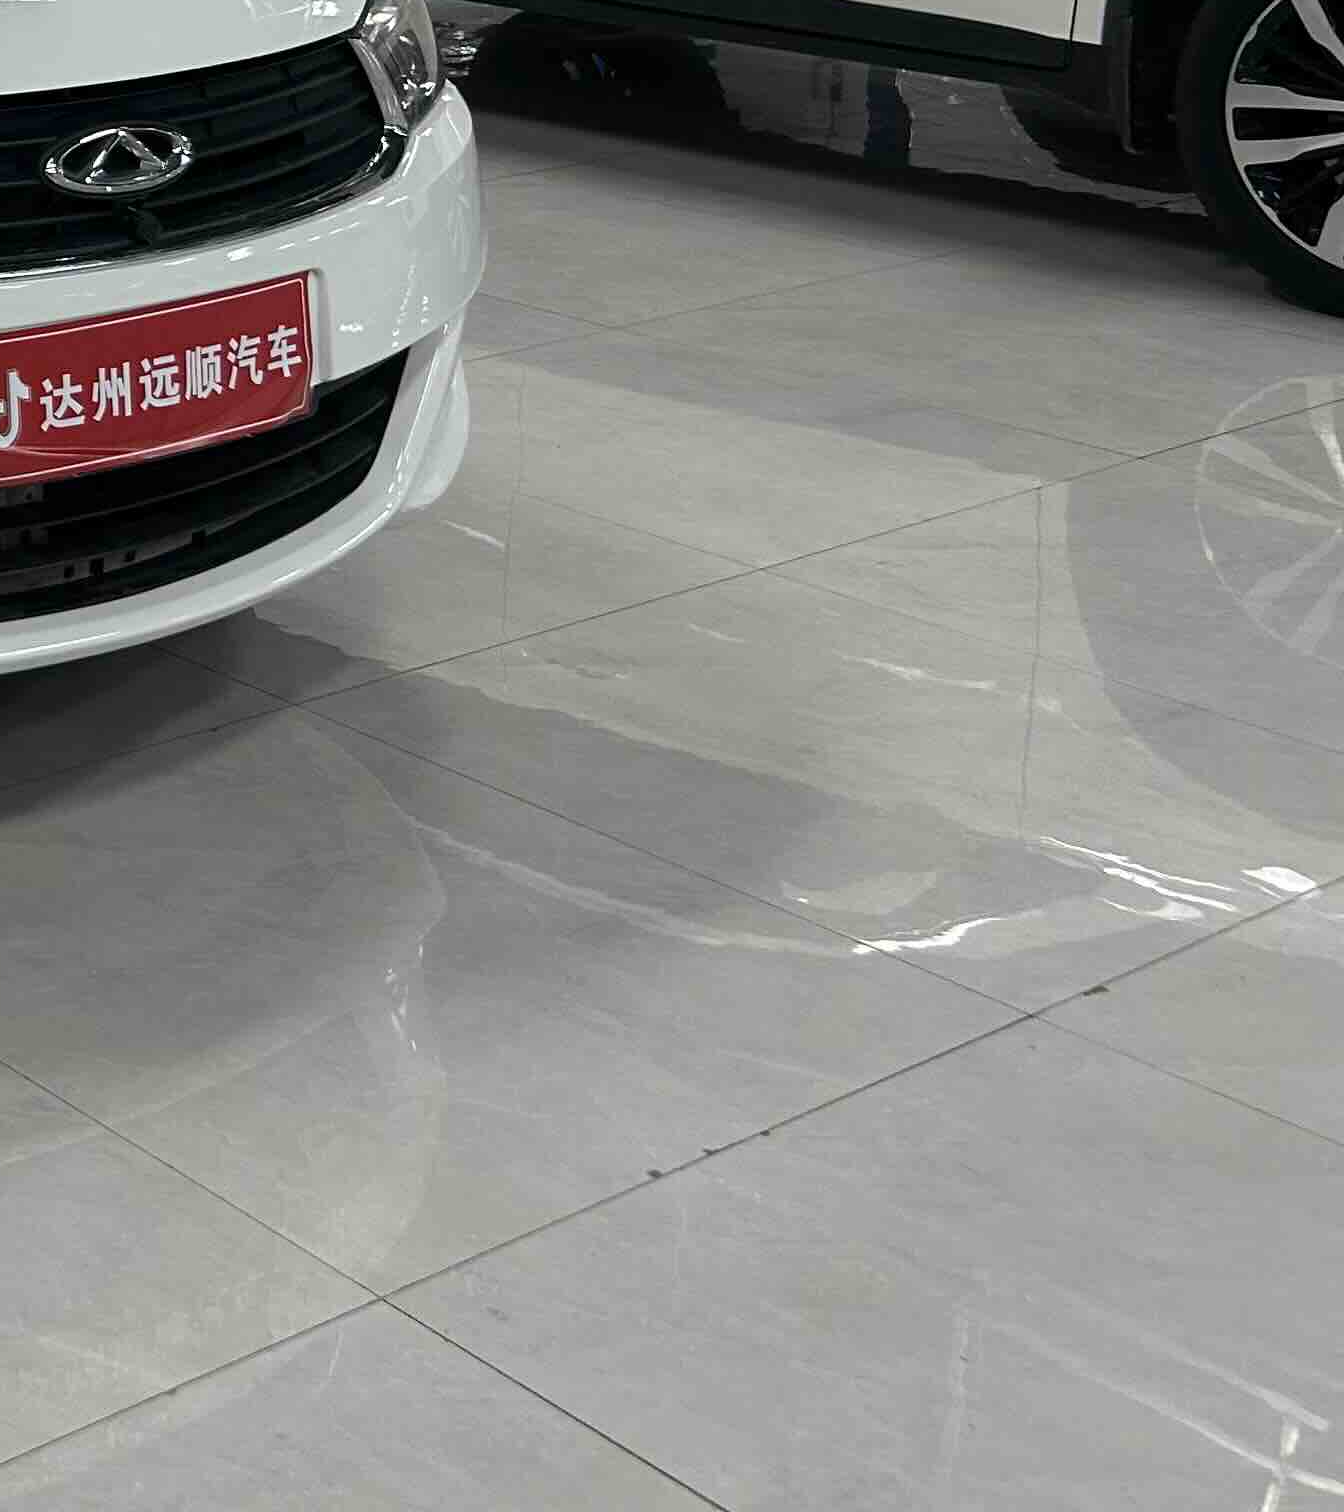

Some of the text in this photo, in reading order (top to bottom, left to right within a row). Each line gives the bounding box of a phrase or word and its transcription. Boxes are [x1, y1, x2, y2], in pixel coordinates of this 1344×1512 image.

[39, 324, 303, 432] 达州远顺汽车
